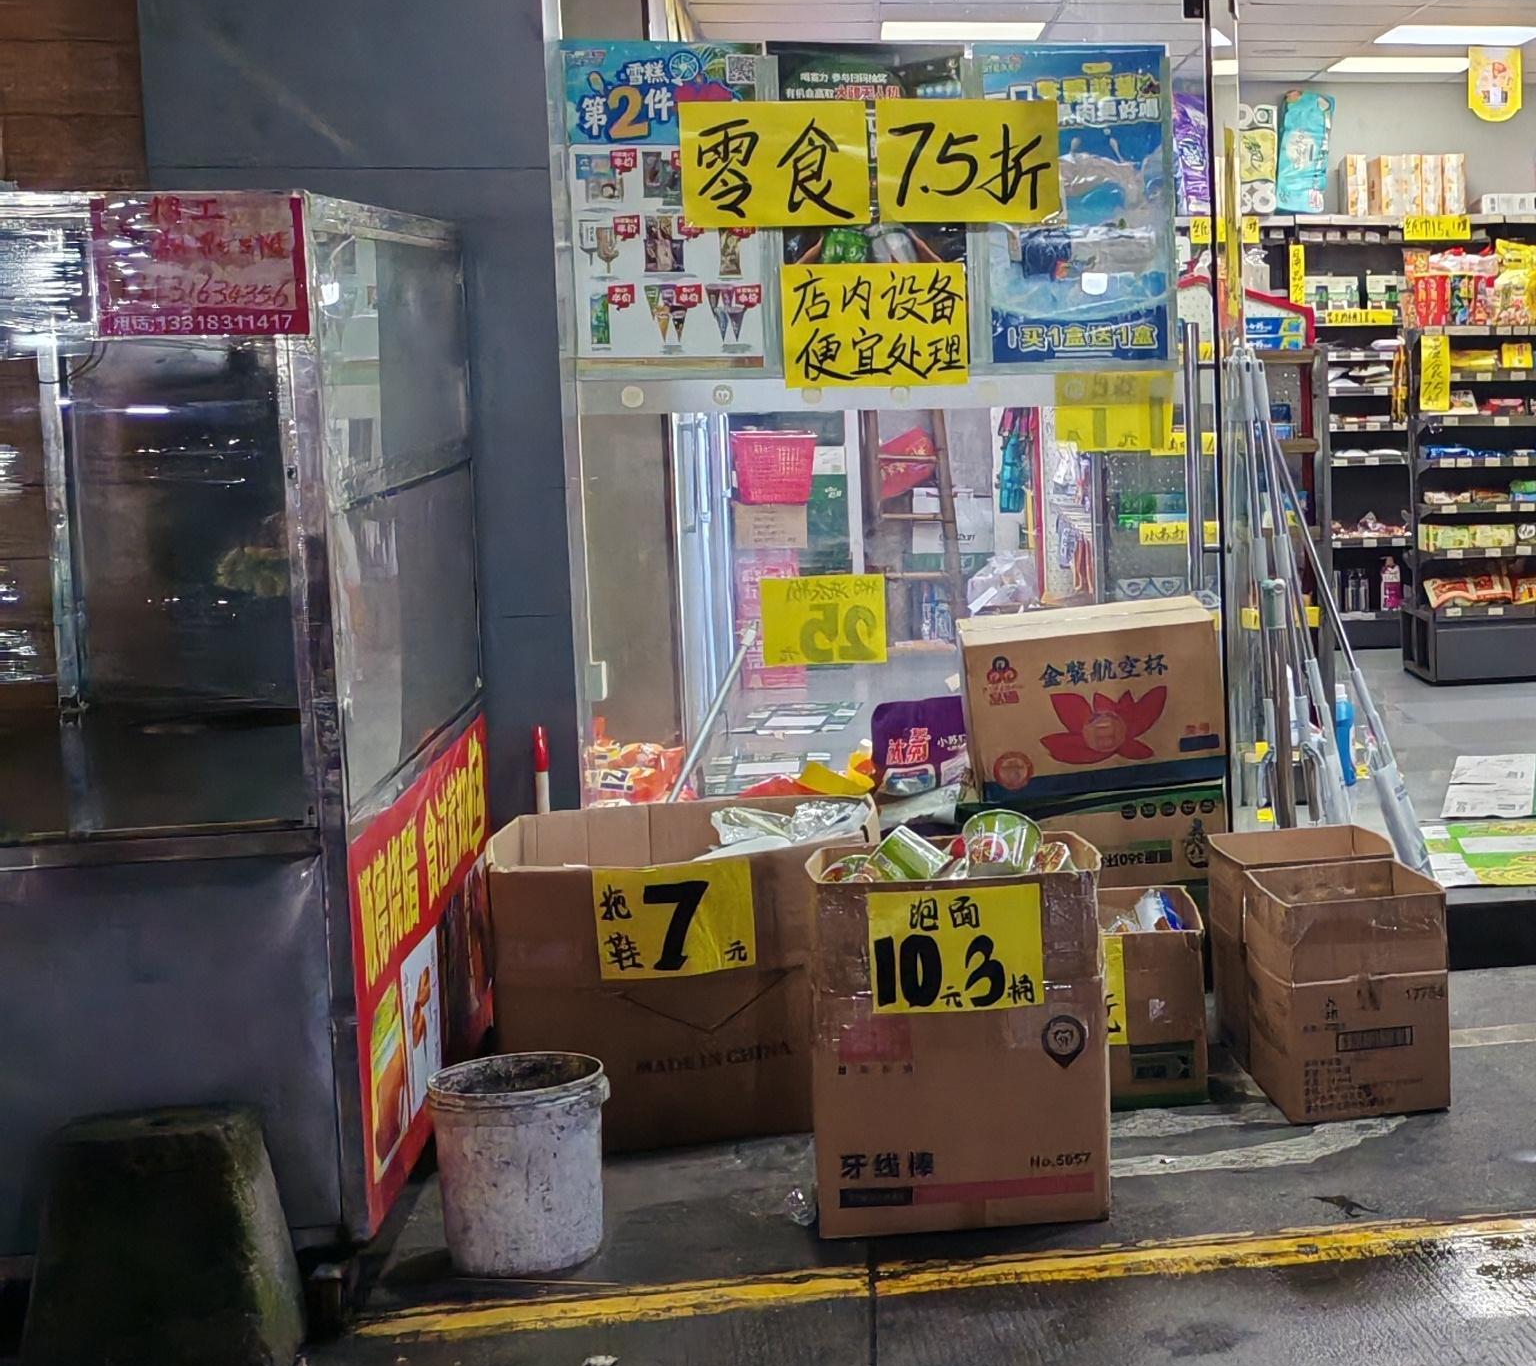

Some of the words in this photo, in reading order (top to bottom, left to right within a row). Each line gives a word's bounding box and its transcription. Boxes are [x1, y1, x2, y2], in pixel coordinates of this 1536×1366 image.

[697, 117, 855, 219] 零食
[791, 269, 963, 326] 店内设备
[796, 328, 966, 380] 便宜处理
